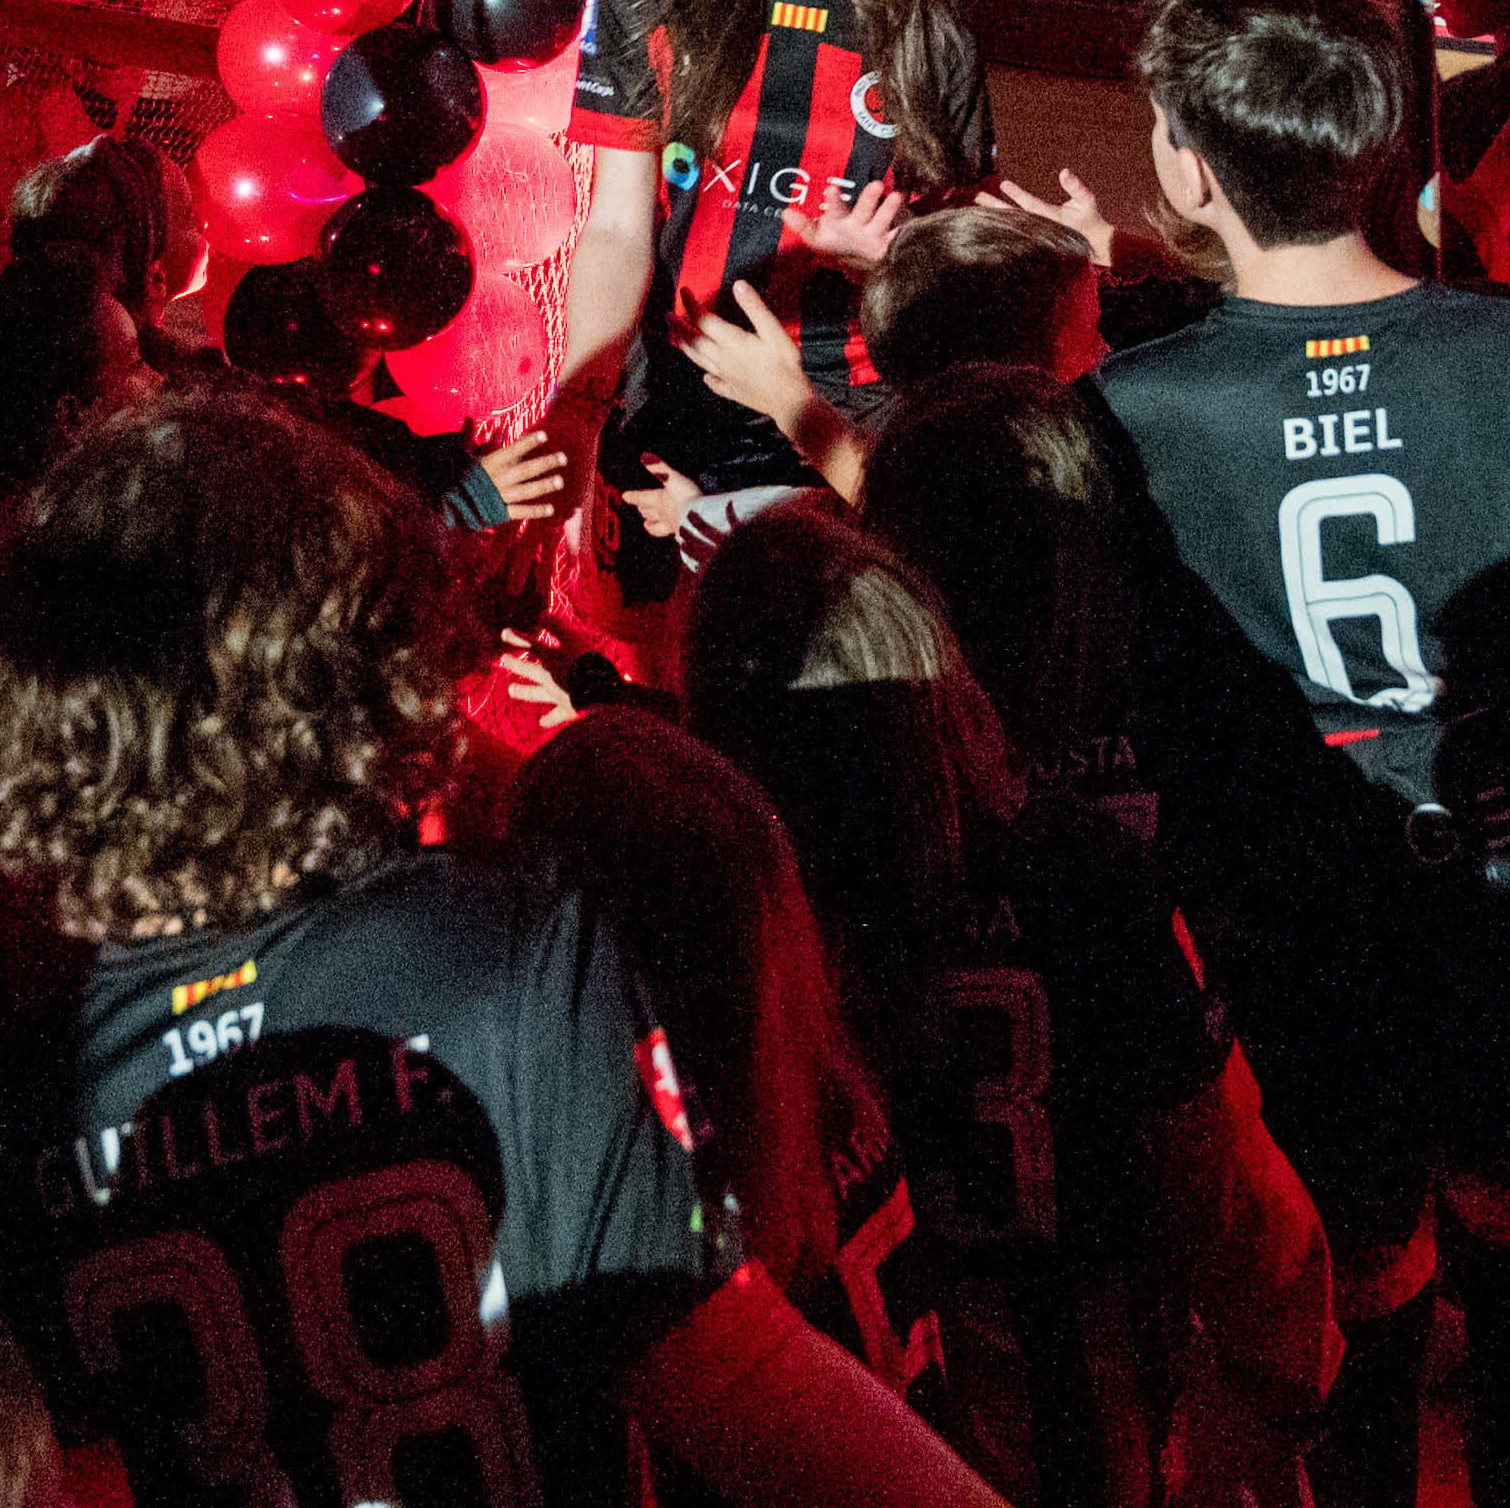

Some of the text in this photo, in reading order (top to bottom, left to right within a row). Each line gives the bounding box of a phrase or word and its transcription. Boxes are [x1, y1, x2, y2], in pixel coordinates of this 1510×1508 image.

[1282, 408, 1403, 460] BIEL
[1305, 363, 1371, 398] 1967
[1278, 473, 1446, 714] 6
[163, 1001, 266, 1076] 1967
[35, 1057, 365, 1220] GUILLEM
[62, 1158, 548, 1507] 38
